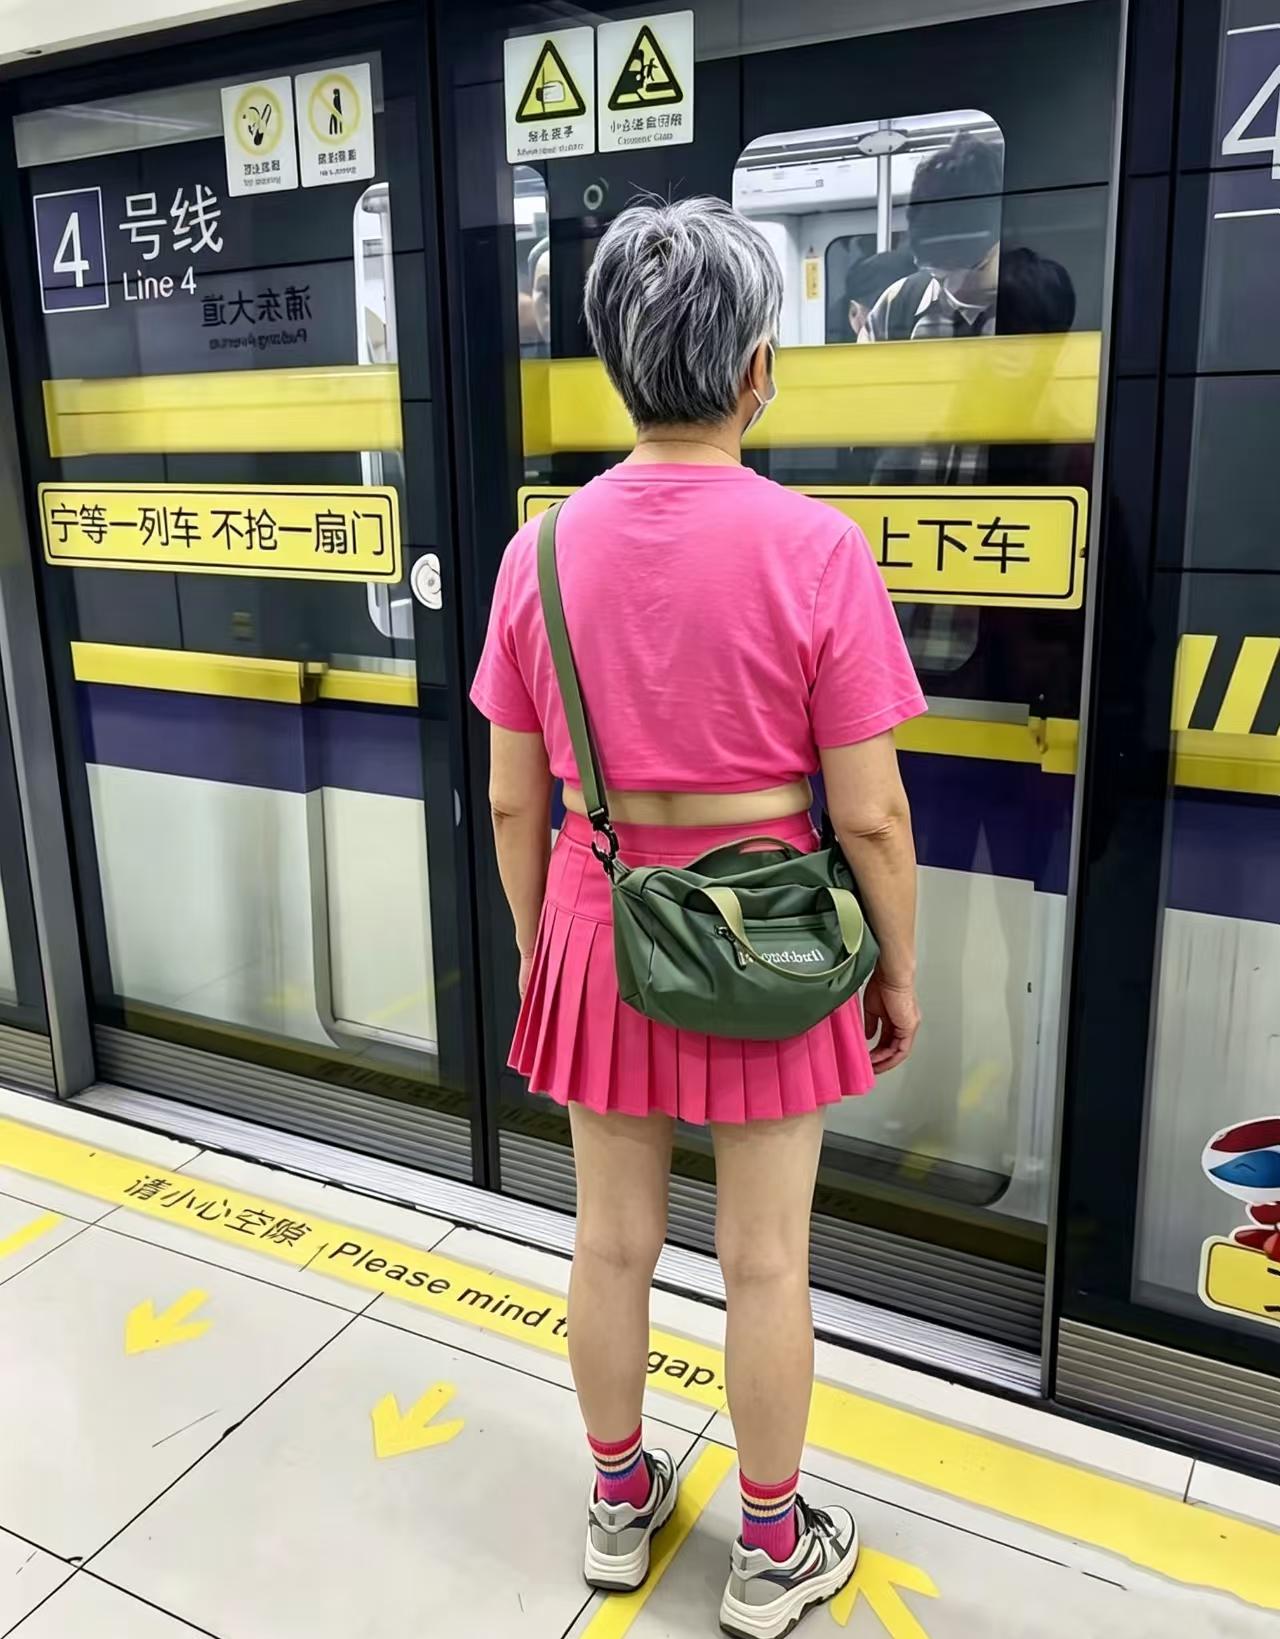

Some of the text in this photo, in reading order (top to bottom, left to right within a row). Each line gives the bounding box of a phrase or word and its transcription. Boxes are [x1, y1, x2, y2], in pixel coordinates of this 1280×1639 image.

[53, 212, 90, 288] 4
[119, 184, 224, 260] 号线
[123, 266, 197, 301] Line 4
[50, 503, 386, 557] 宁等一列车 不抢一扇门
[877, 516, 1030, 573] 上下车
[123, 1175, 313, 1247] 请小心空隙
[327, 1241, 451, 1294] Please
[456, 1287, 552, 1328] mind
[647, 1351, 724, 1390] gap.
